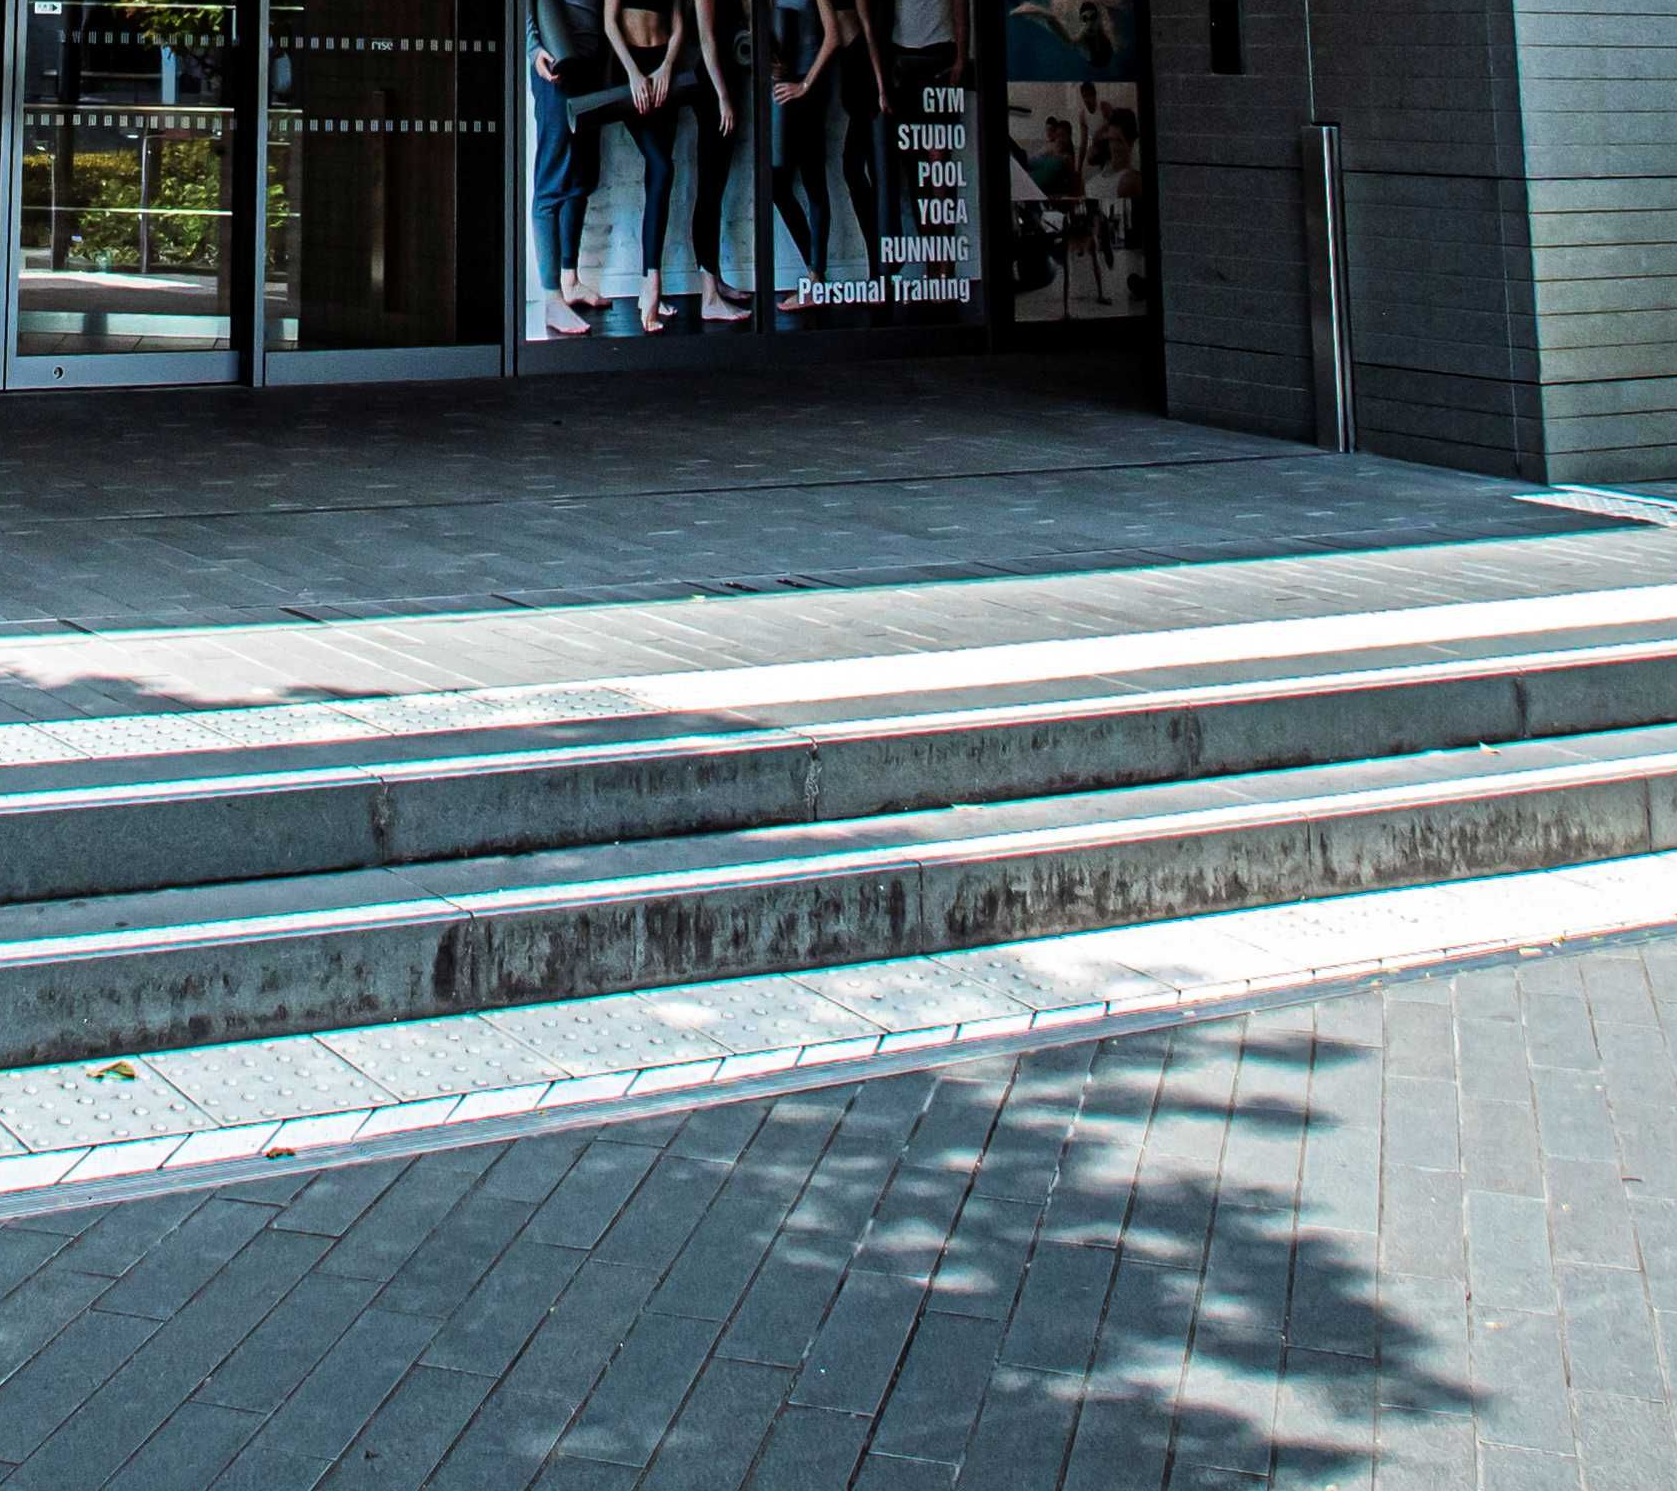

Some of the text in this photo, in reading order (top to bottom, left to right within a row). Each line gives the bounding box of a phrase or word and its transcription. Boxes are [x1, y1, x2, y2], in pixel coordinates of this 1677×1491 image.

[922, 87, 965, 113] GYM
[898, 124, 966, 151] STUDIO
[917, 161, 967, 187] POOL
[917, 198, 968, 225] YOGA
[880, 235, 969, 263] RUNNING
[798, 273, 970, 305] Personal Training
